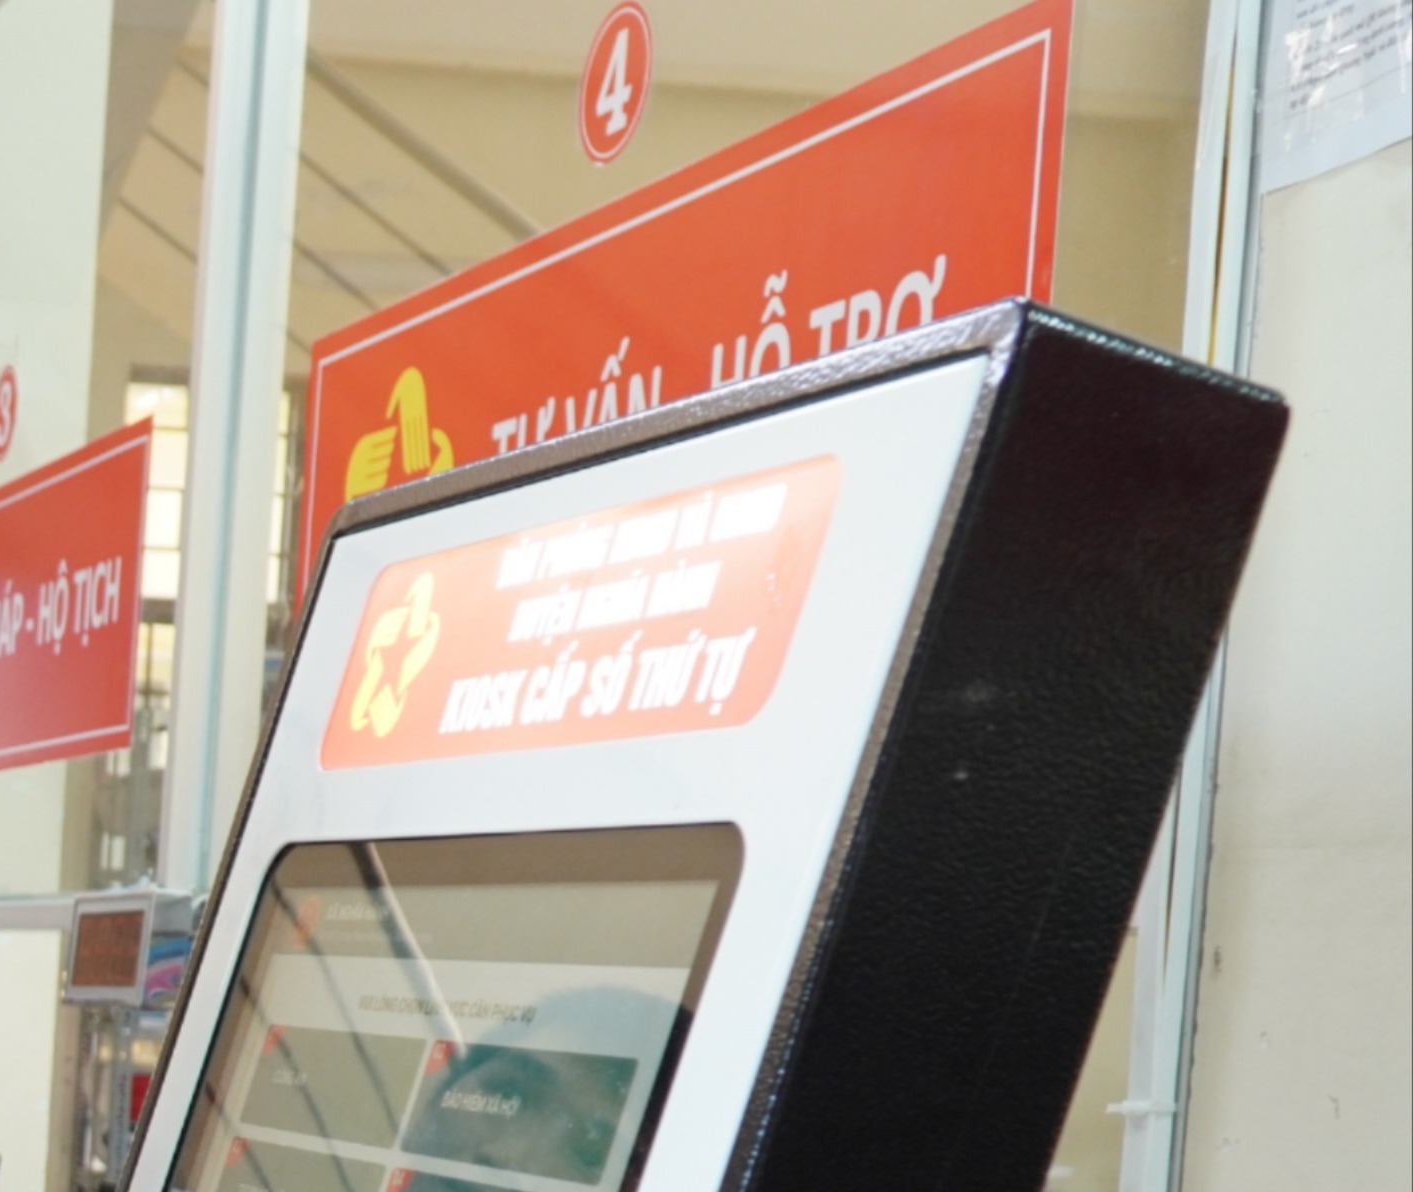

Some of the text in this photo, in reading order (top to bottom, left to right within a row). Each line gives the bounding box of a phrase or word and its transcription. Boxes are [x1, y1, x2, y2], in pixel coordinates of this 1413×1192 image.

[595, 27, 633, 136] 4
[36, 557, 71, 656] HỘ
[72, 556, 122, 647] TỊCH
[439, 626, 758, 734] KIOSK CẤP SỐ THỨ TỰ
